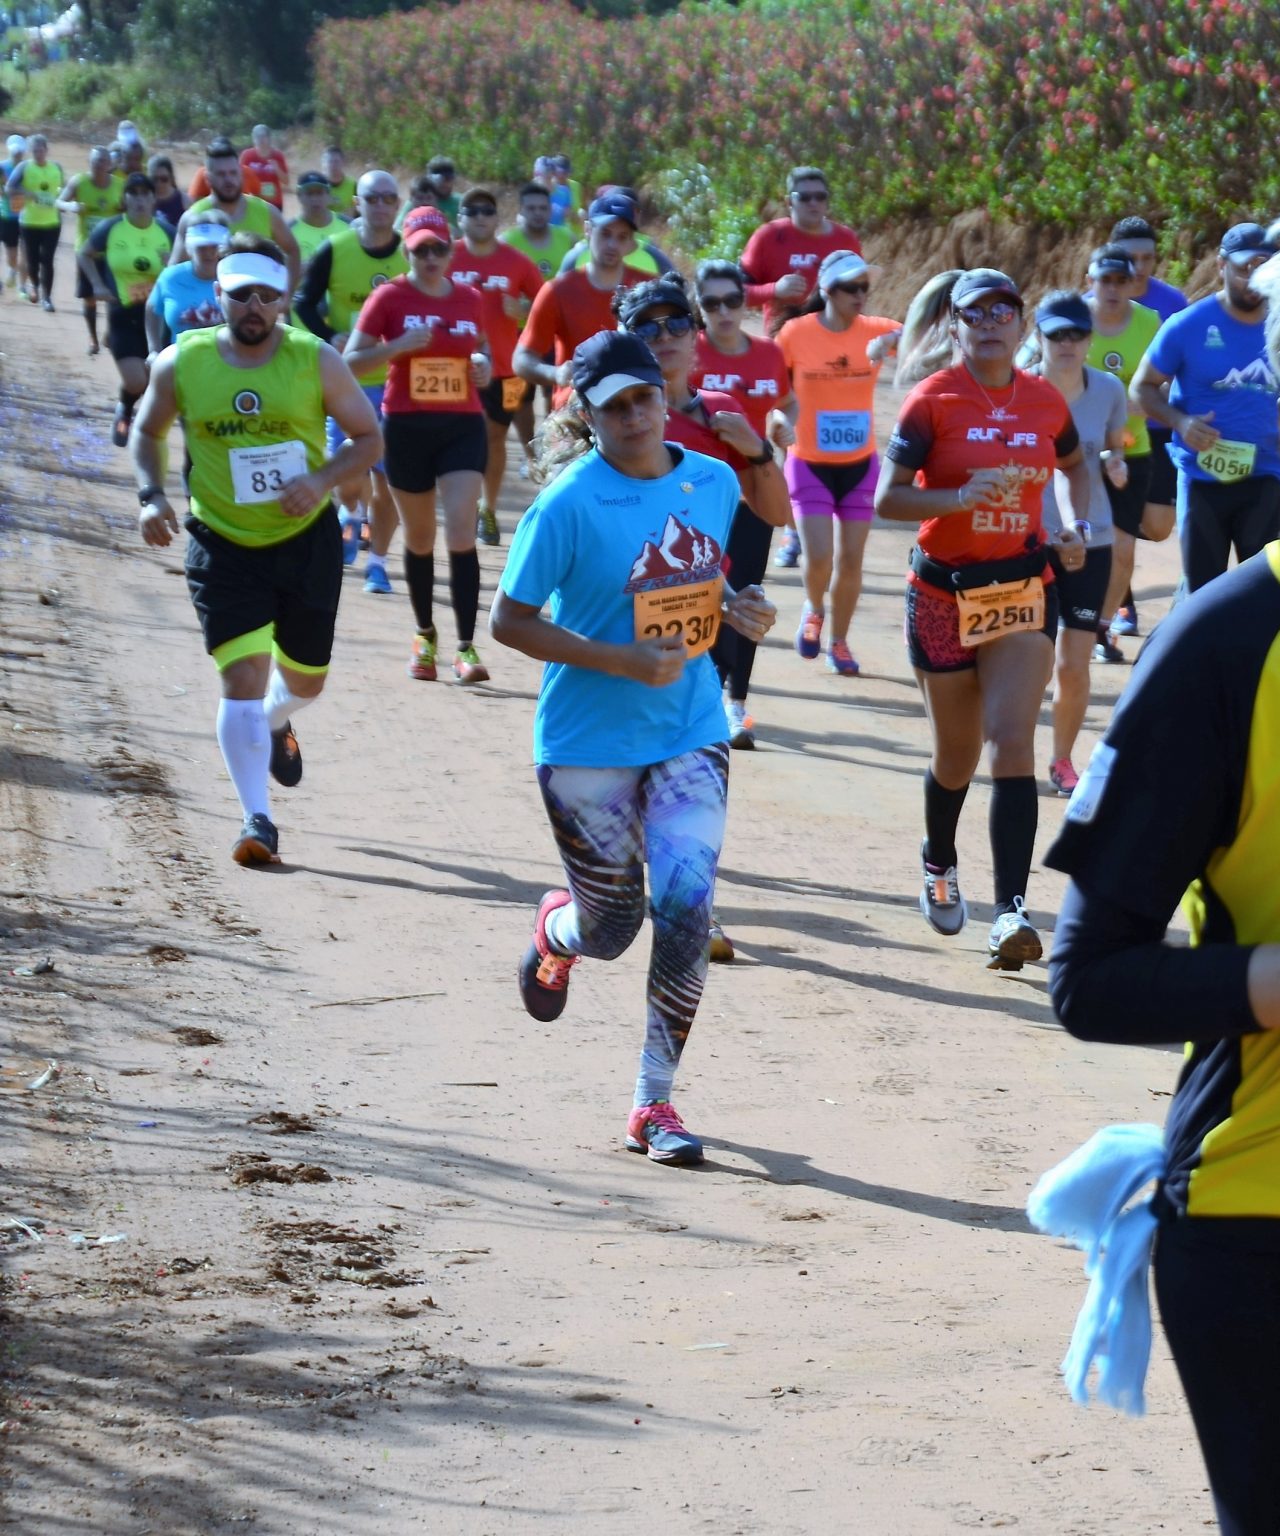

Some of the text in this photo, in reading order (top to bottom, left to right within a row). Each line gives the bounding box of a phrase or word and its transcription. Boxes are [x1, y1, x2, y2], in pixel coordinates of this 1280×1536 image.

[415, 376, 461, 393] 2211
[820, 427, 864, 445] 3061
[1201, 453, 1250, 476] 4051
[251, 469, 283, 493] 83
[972, 509, 1029, 533] ELITE
[967, 605, 1034, 636] 2251
